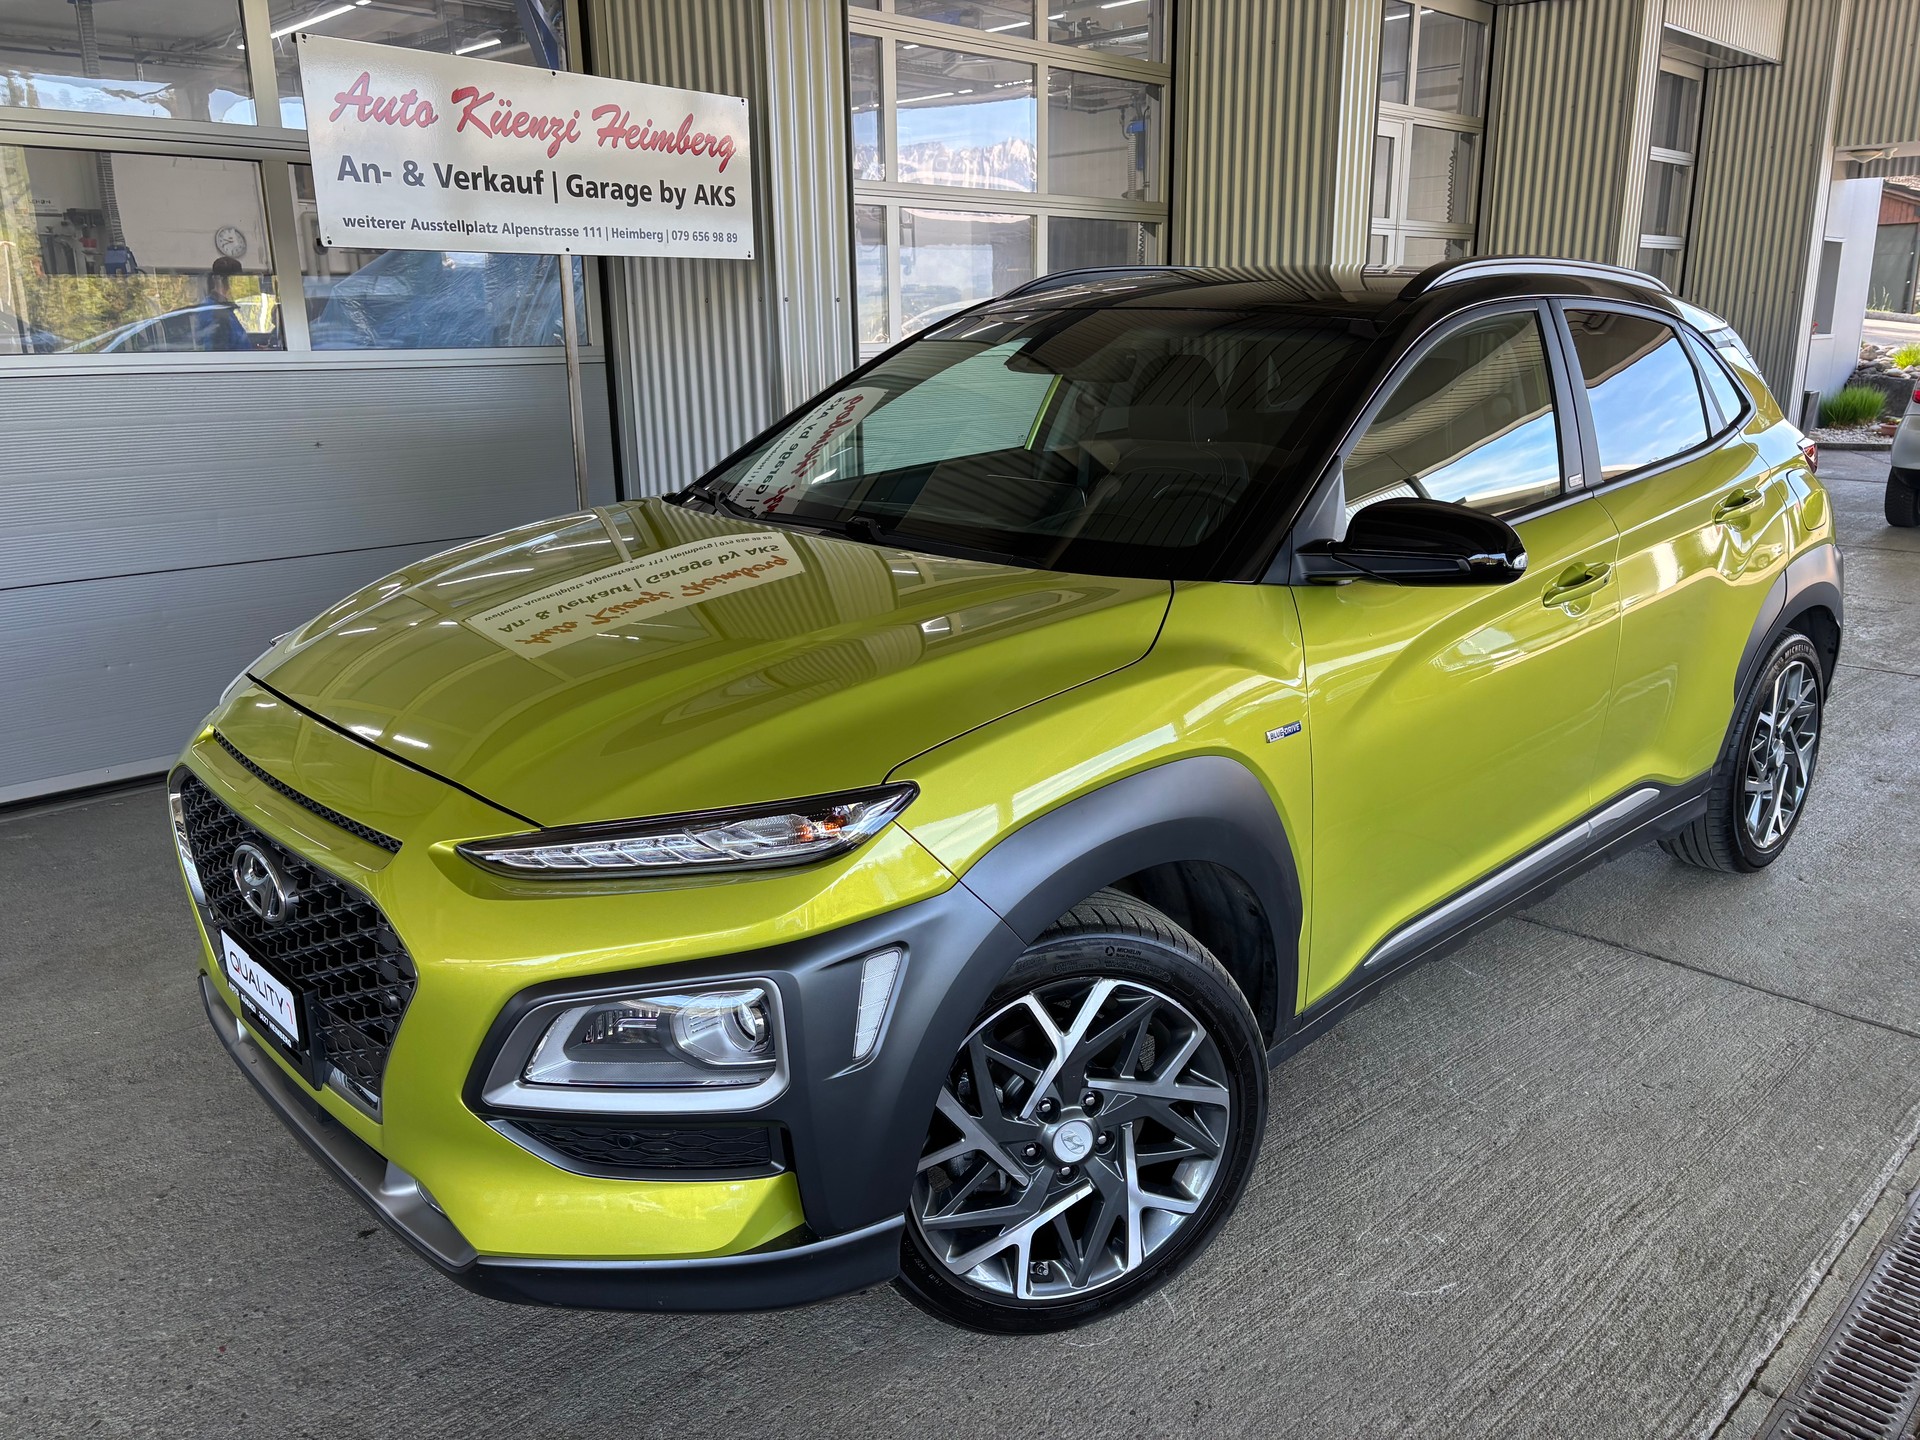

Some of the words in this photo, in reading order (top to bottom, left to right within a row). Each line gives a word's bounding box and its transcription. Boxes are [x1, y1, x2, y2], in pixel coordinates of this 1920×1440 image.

[329, 71, 439, 128] Auto
[451, 86, 581, 159] Küenzi
[591, 104, 738, 173] Heimberg
[337, 155, 392, 184] An-
[402, 160, 425, 188] &
[433, 162, 545, 196] Verkauf
[566, 173, 653, 208] Garage
[660, 179, 687, 210] by
[694, 183, 737, 208] AKS
[342, 214, 406, 231] weiterer
[411, 216, 498, 236] Ausstellplatz
[502, 222, 580, 239] Alpenstrasse
[583, 225, 602, 239] 111
[611, 227, 664, 244] Heimberg
[671, 229, 689, 242] 079
[692, 230, 710, 242] 656
[713, 232, 724, 243] 98
[726, 232, 738, 244] 89
[1116, 946, 1142, 956] MICHELIN
